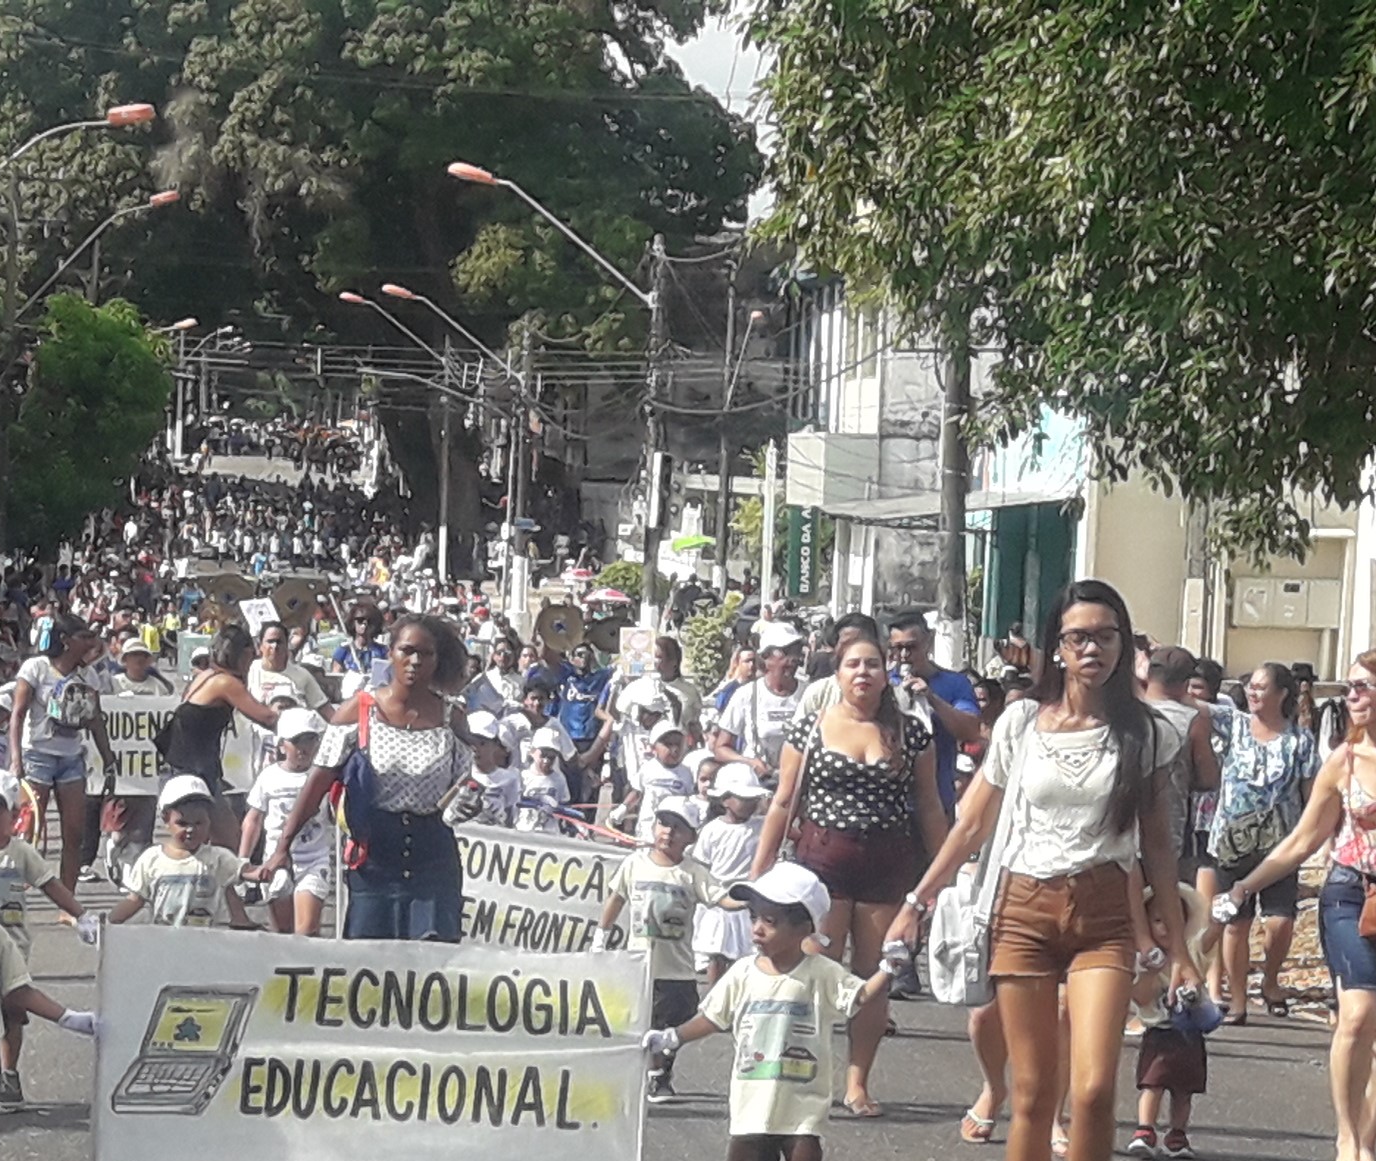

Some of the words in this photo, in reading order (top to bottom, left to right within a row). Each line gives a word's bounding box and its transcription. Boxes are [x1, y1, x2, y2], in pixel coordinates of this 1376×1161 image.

[800, 505, 812, 519] A
[800, 523, 812, 543] DA
[799, 546, 811, 592] BANCO
